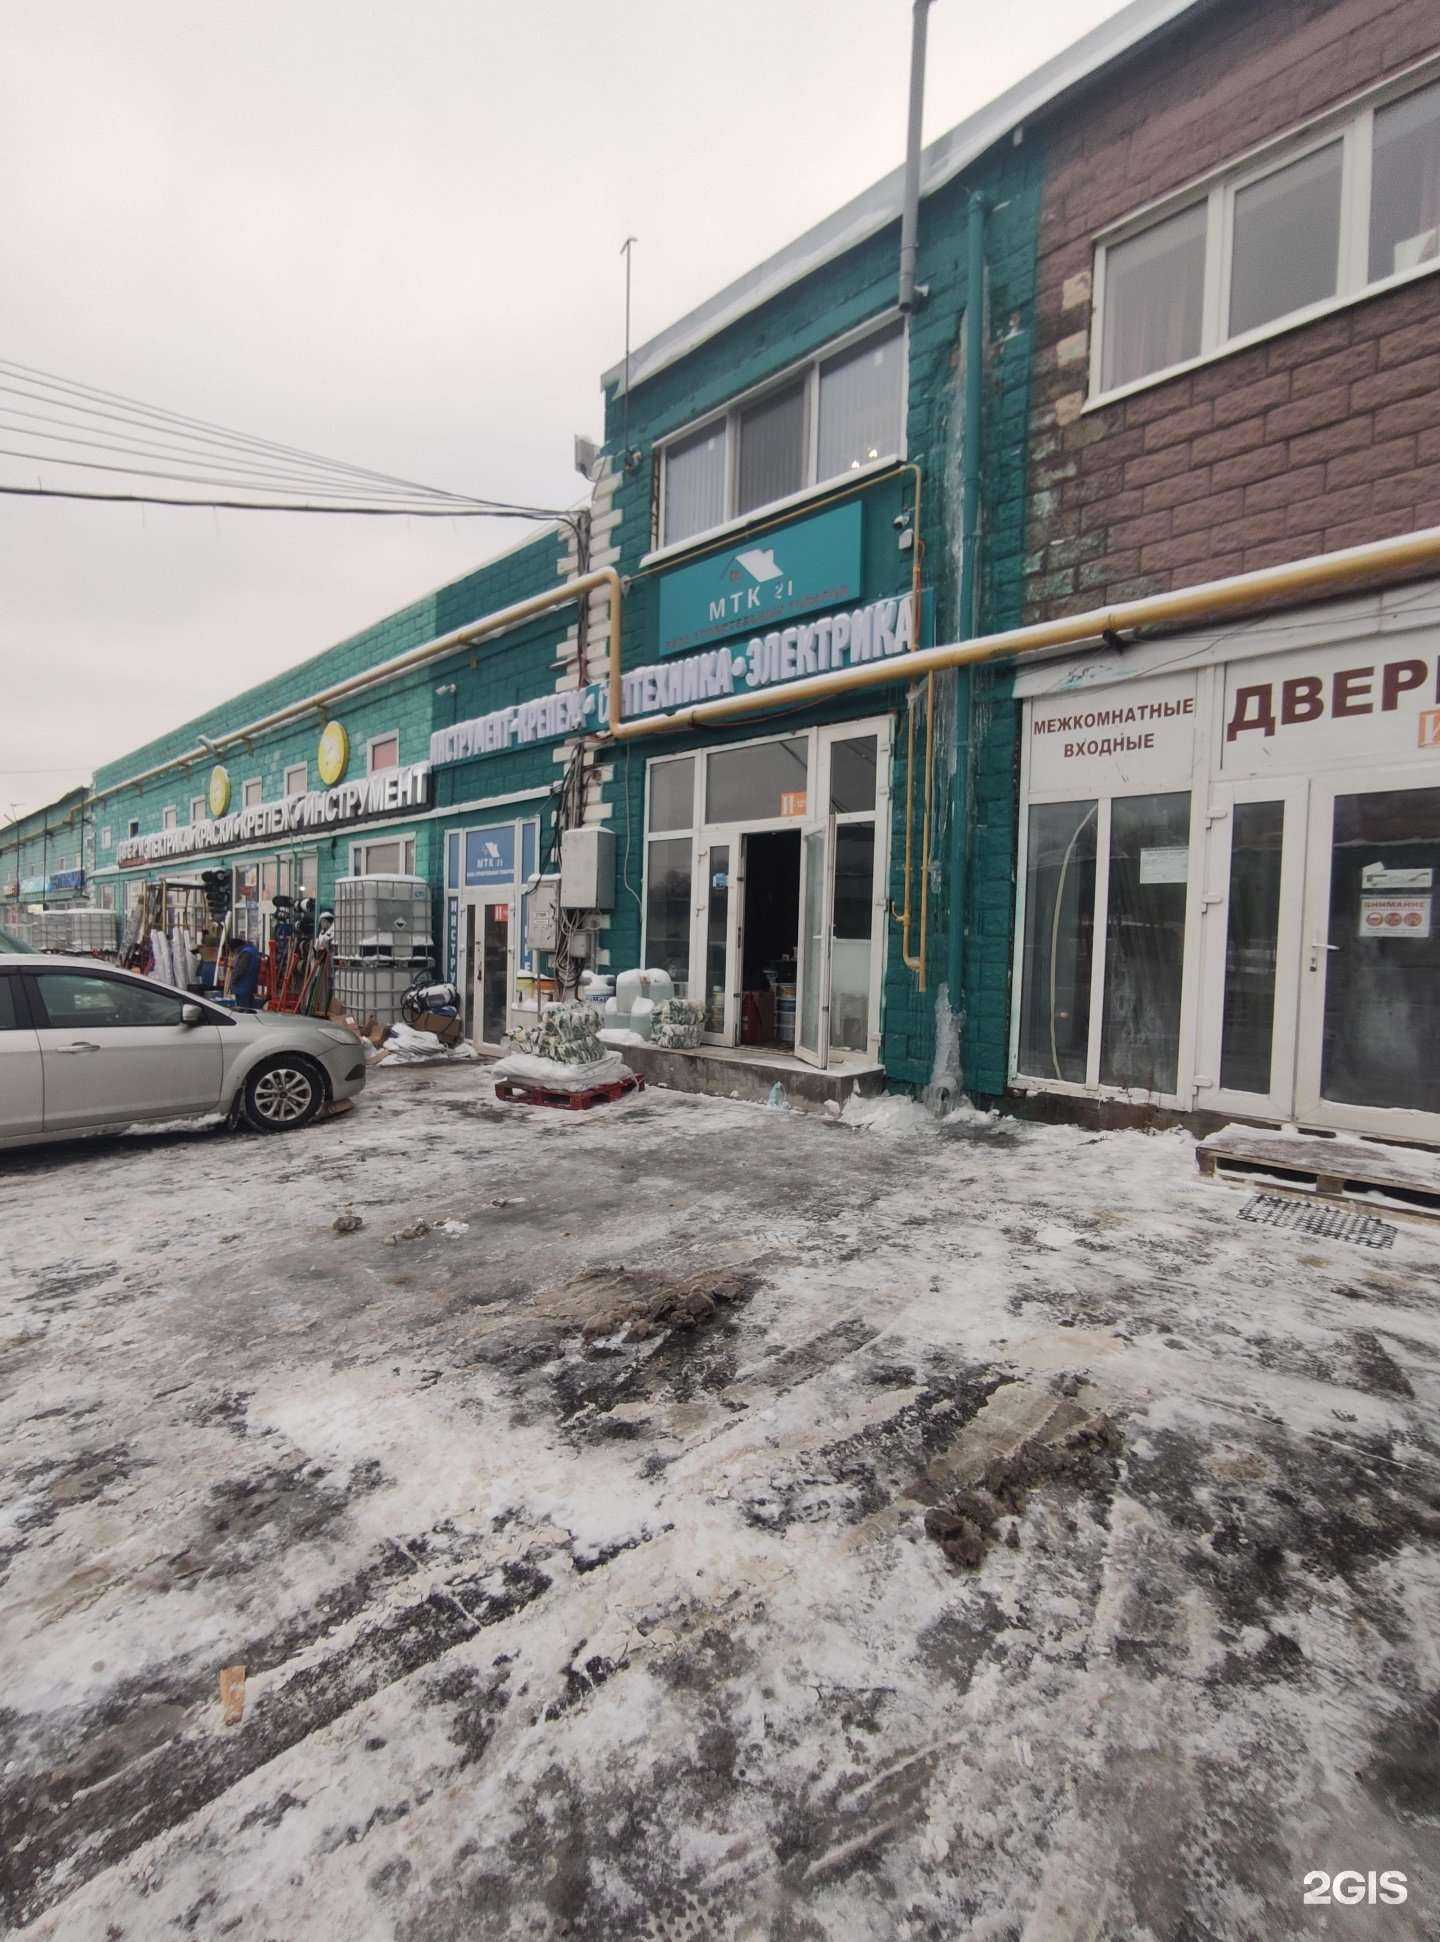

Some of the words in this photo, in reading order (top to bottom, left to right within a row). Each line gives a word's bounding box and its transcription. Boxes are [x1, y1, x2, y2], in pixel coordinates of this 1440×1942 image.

[709, 586, 761, 622] МТК
[598, 648, 734, 724] СНТЕХНИКА
[745, 596, 914, 687] ЭЛЕКТРИКА
[1033, 698, 1194, 735] МЕЖКОМНАТНЫЕ
[1226, 655, 1440, 742] ДВЕР
[1064, 733, 1155, 758] ВХОДНЫЕ
[240, 801, 295, 841] КРЕПЕЖ
[303, 767, 428, 827] ИНСТРУМЕНТ
